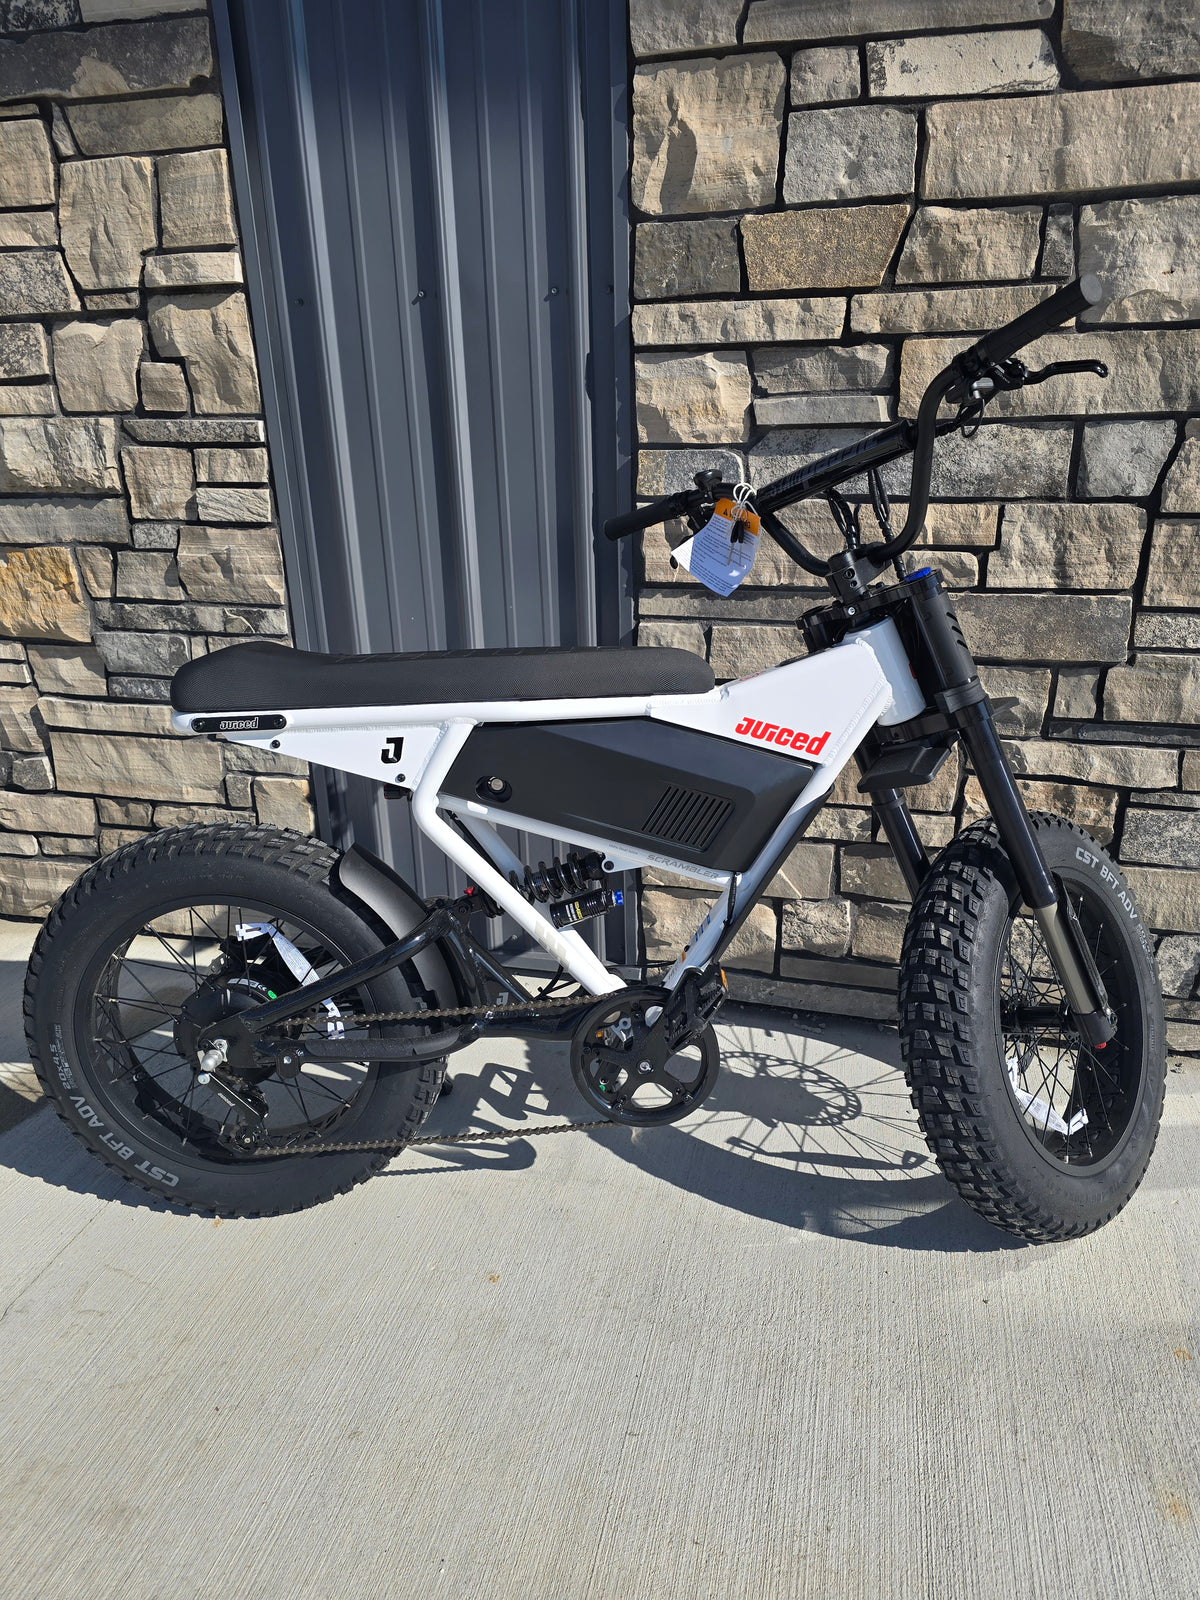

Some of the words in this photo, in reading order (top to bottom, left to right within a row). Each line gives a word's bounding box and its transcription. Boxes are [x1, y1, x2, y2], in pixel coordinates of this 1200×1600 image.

[380, 736, 405, 765] J
[646, 854, 720, 880] SCRAMBLER
[1075, 846, 1099, 869] CST
[1100, 864, 1120, 890] BFT
[1118, 891, 1138, 919] ADV
[69, 1095, 105, 1129] ADV
[99, 1132, 135, 1161] BFT
[134, 1160, 180, 1188] CST
